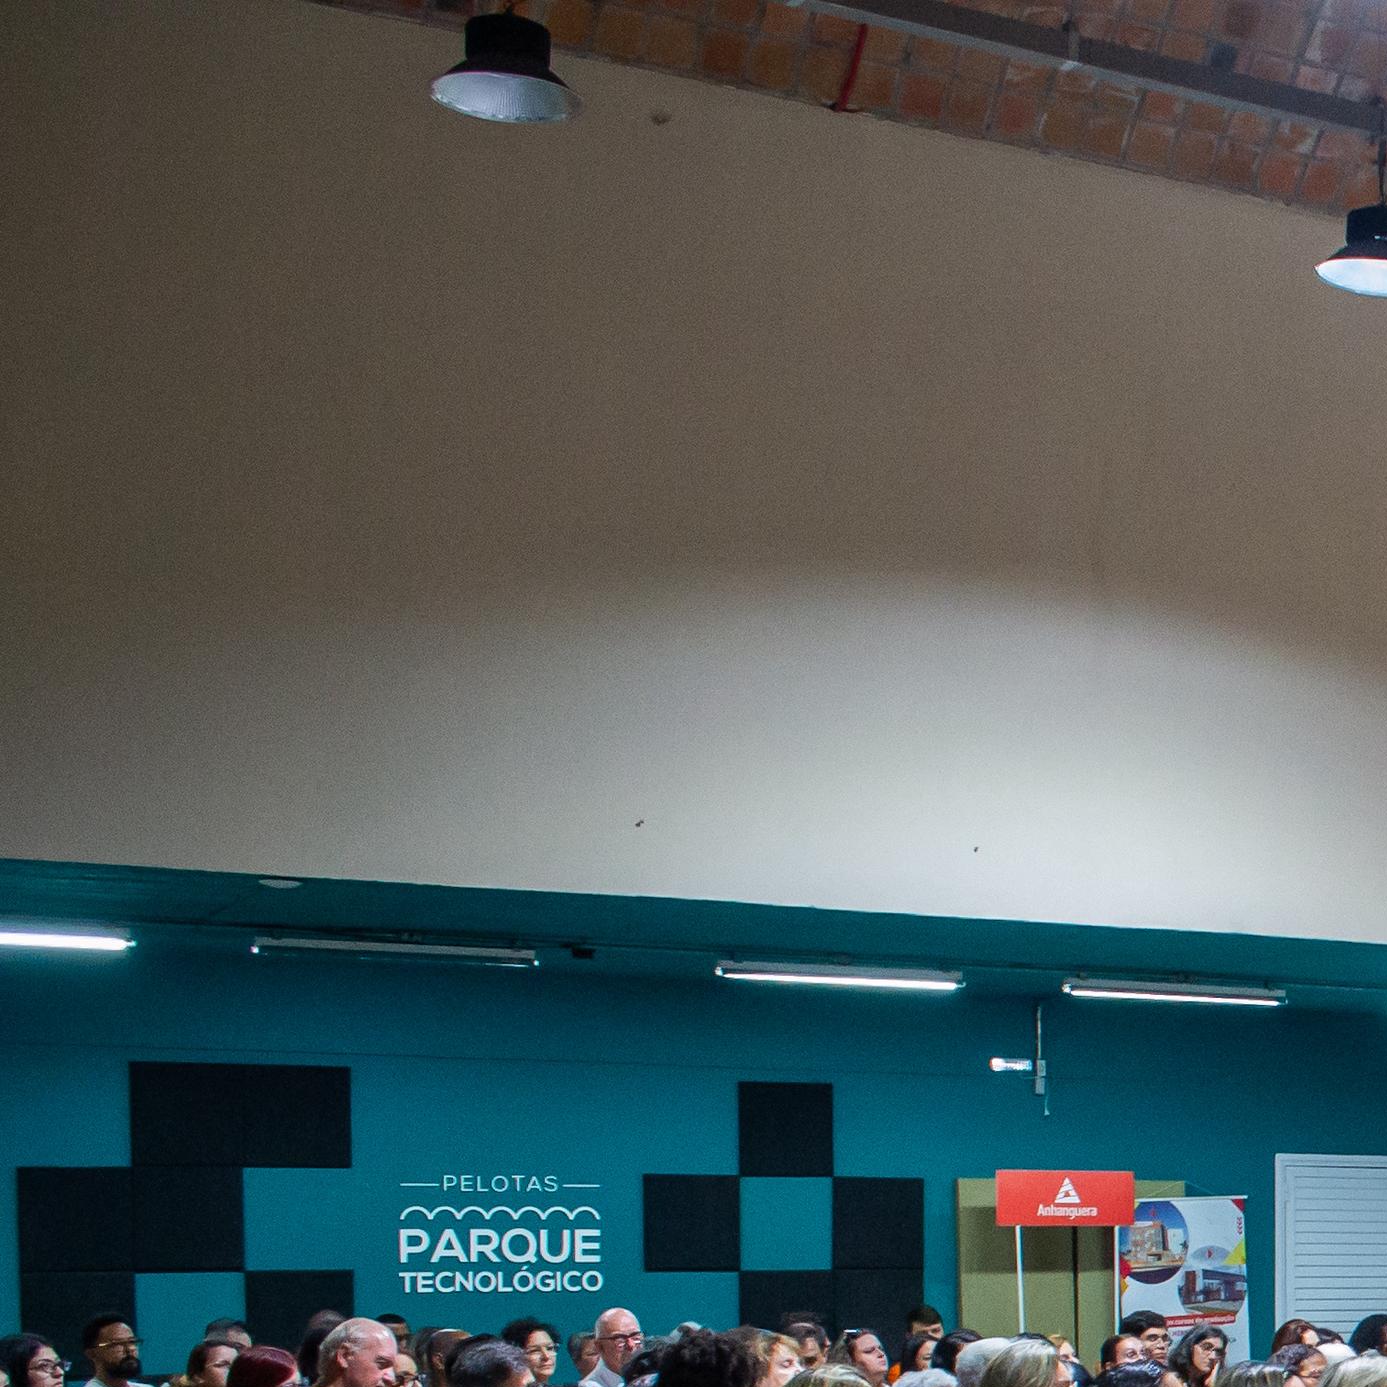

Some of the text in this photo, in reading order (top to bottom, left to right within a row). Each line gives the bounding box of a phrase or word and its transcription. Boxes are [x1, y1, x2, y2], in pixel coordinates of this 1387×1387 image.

[442, 1174, 559, 1192] PELOTAS
[1036, 1203, 1098, 1220] Anhanguera
[398, 1228, 601, 1264] PARQUE
[398, 1265, 603, 1293] TECNOLÓGICO
